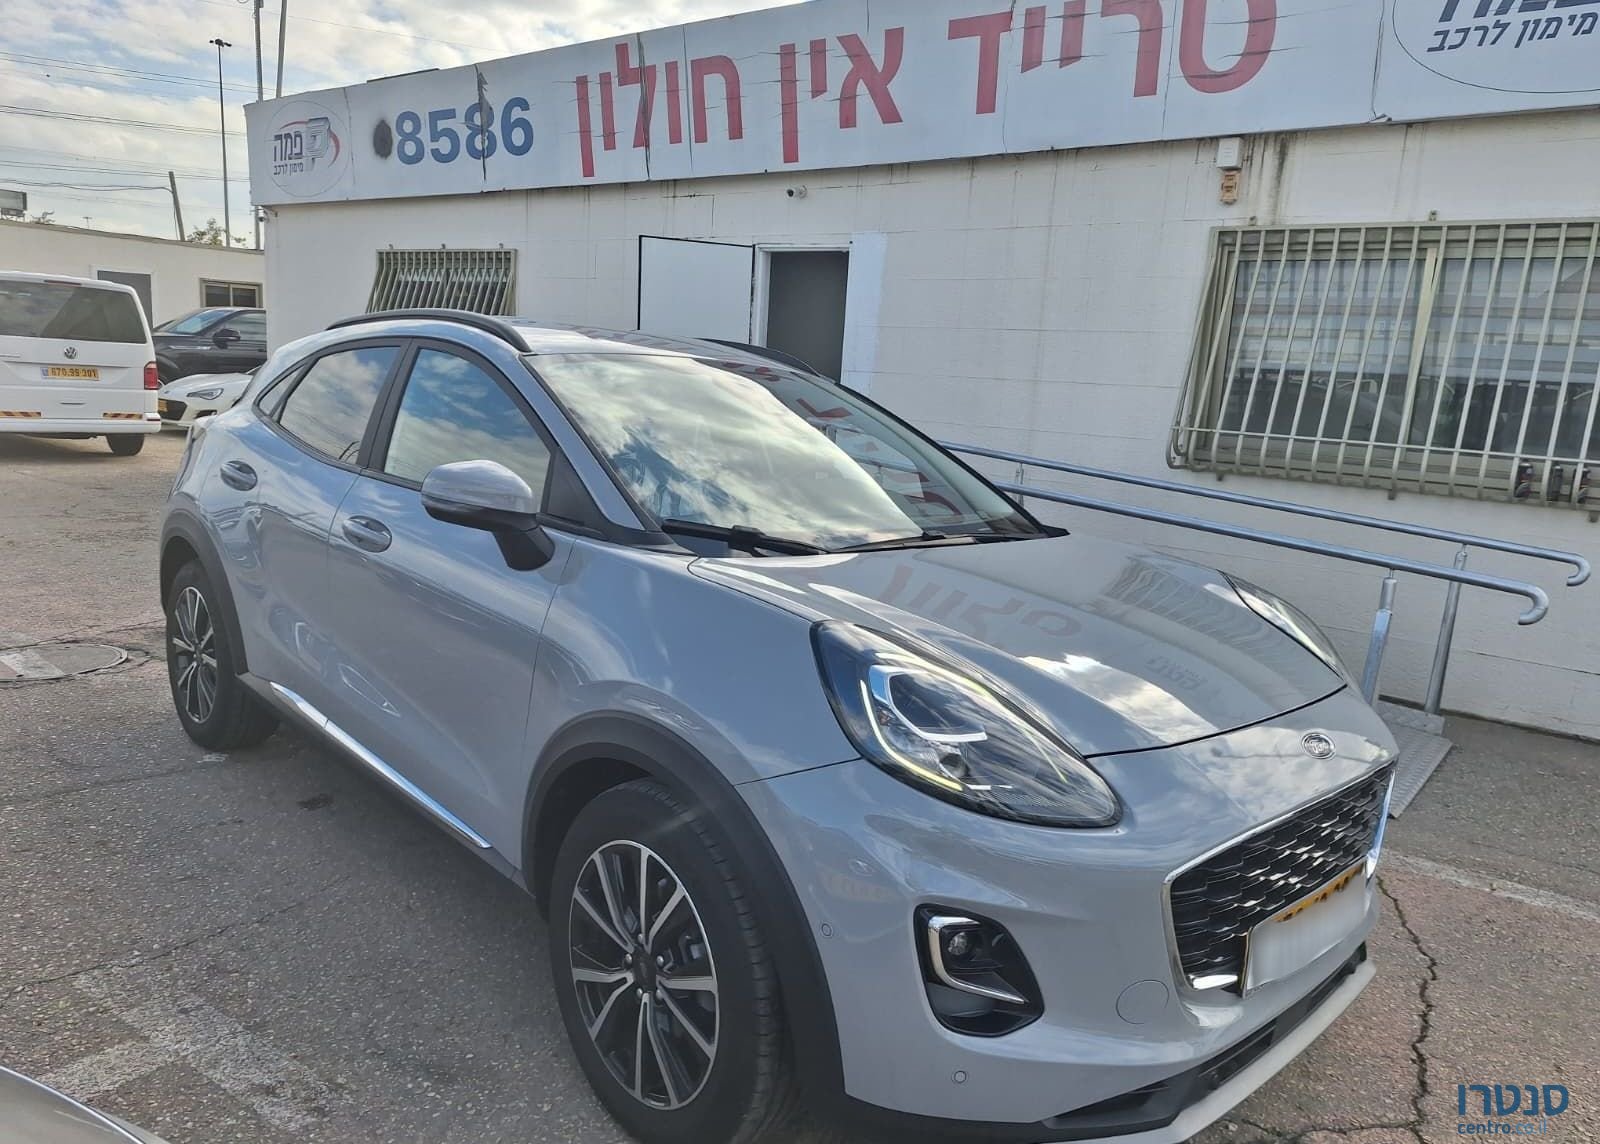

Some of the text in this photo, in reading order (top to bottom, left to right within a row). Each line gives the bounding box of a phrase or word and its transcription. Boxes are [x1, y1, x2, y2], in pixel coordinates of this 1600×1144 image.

[1426, 19, 1511, 52] לרכב
[1513, 11, 1600, 49] מימון
[575, 0, 1277, 178] טרייד אין חולון
[395, 96, 534, 165] 8586
